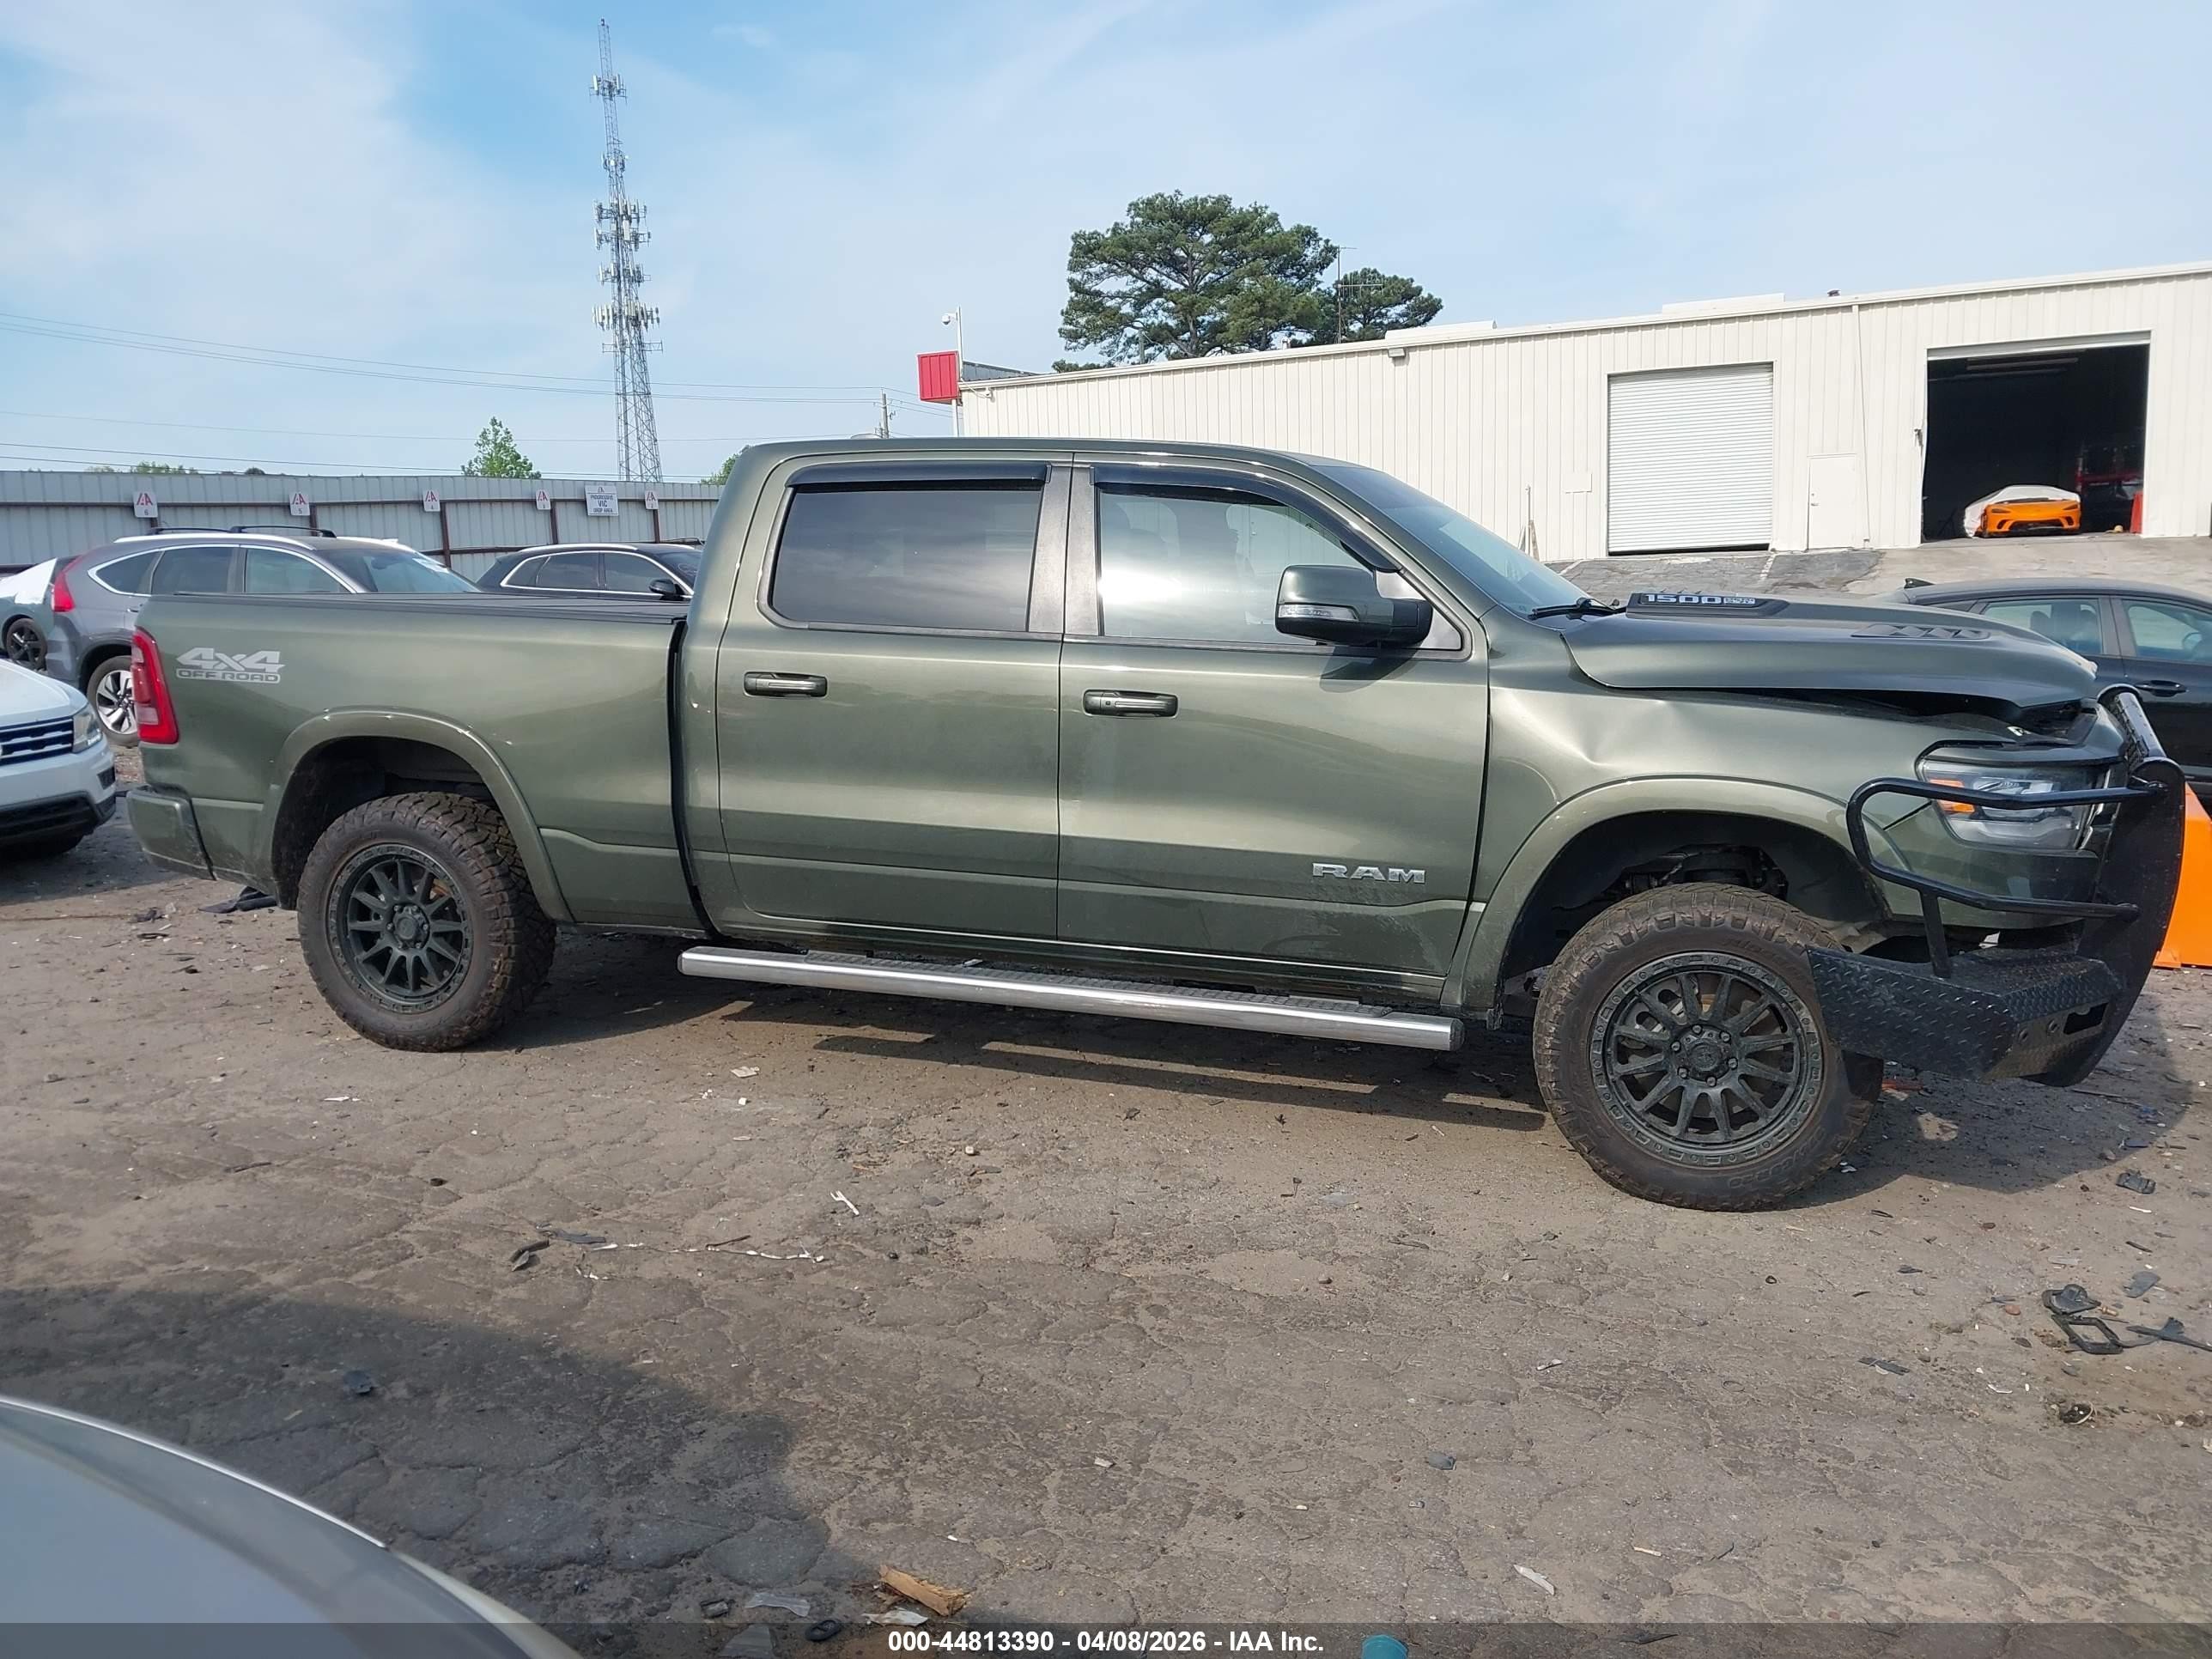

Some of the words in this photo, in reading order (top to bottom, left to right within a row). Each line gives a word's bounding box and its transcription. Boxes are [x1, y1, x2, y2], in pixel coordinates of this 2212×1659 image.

[1644, 594, 1722, 605] 1500
[178, 670, 217, 679] OFF
[222, 672, 279, 682] ROAD
[1312, 862, 1425, 884] RAM
